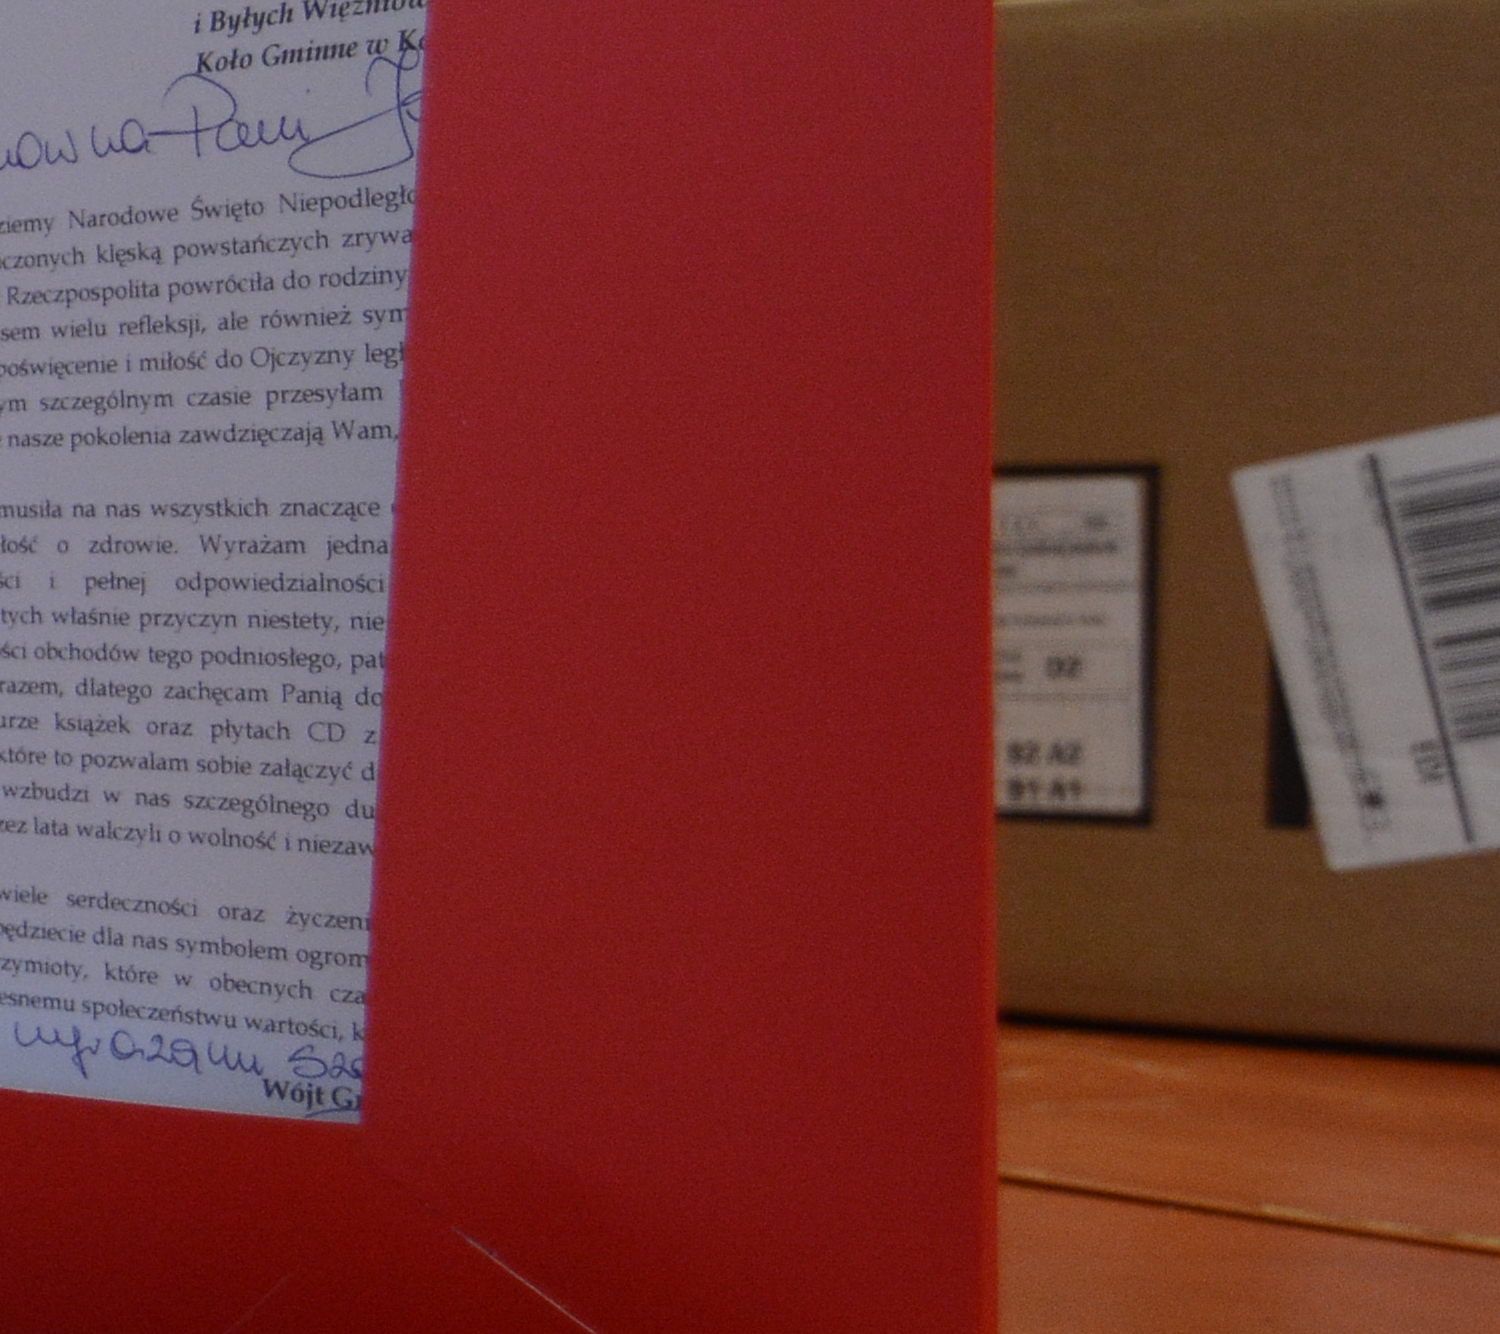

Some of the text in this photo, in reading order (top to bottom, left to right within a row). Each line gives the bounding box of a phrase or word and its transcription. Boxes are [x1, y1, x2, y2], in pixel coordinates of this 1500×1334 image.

[210, 1, 295, 39] Byłych
[197, 46, 257, 75] Koło
[261, 41, 360, 69] Gminne
[69, 205, 181, 231] Narodowe
[191, 195, 267, 224] Święto
[96, 241, 164, 269] klęską
[173, 229, 331, 267] powstańczych
[72, 503, 98, 520] na
[106, 504, 143, 520] nas
[150, 497, 271, 525] wszystkich
[280, 501, 382, 524] znaczące
[89, 535, 180, 557] zdrowie.
[199, 534, 308, 562] Wyrażam
[85, 571, 148, 598] pełnej
[175, 571, 385, 599] odpowiedzialności
